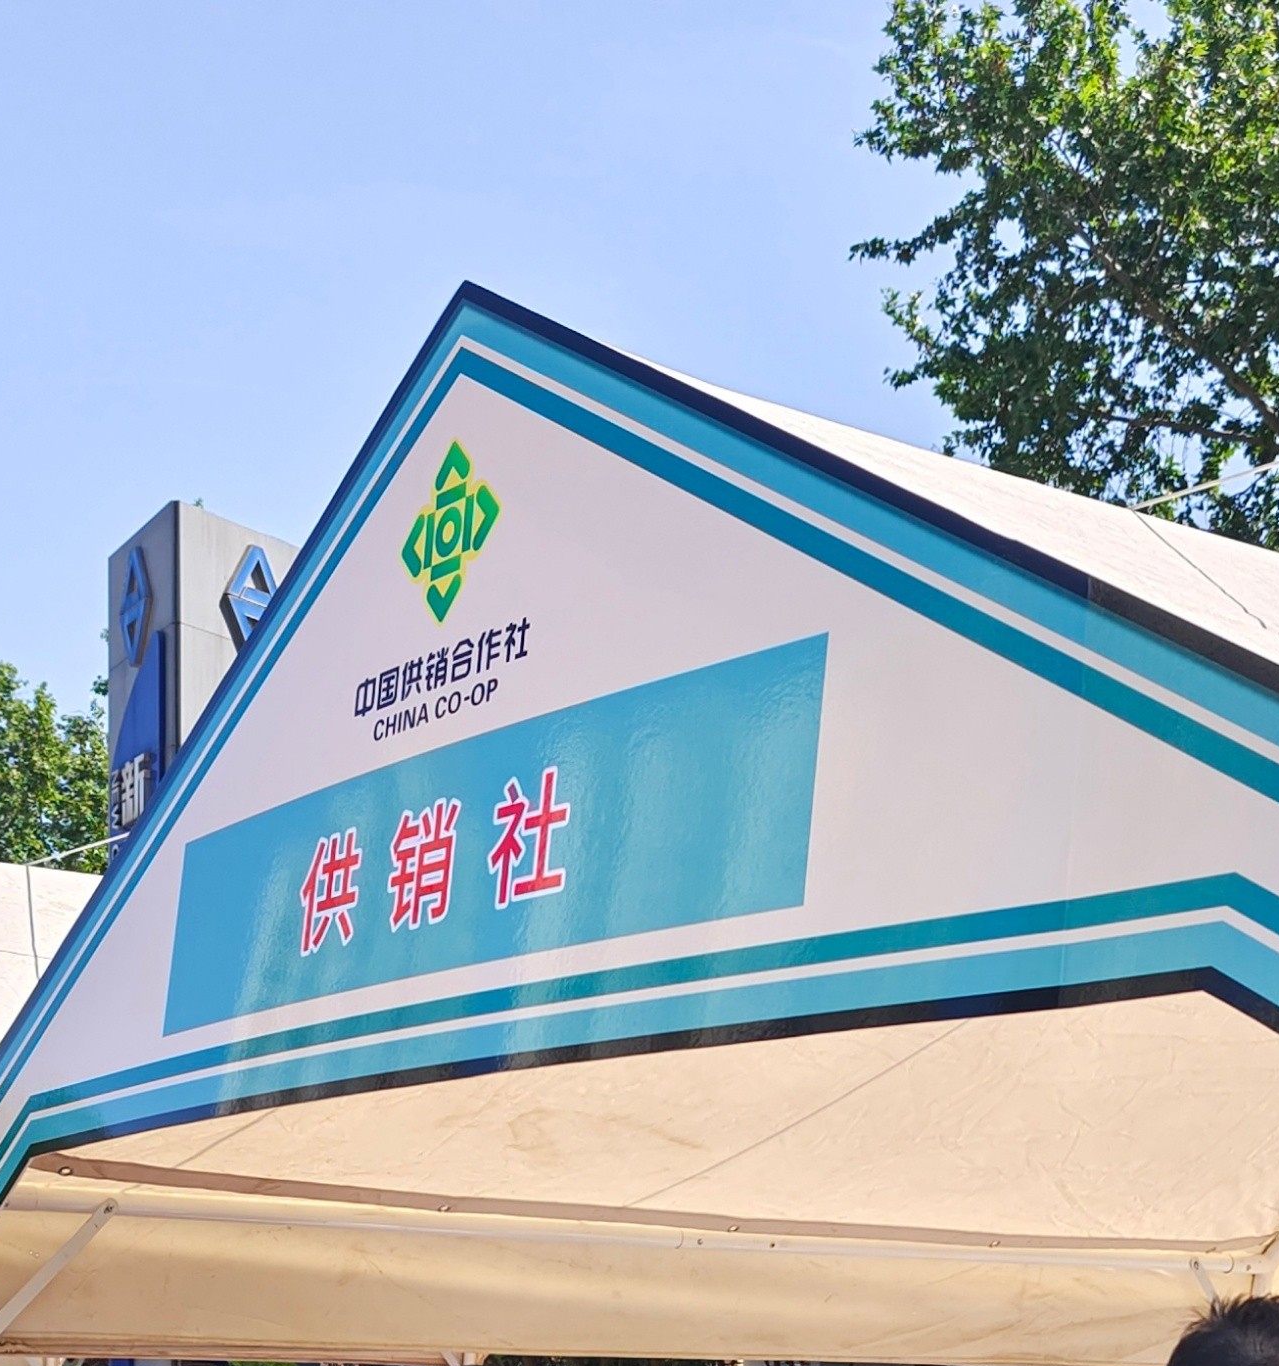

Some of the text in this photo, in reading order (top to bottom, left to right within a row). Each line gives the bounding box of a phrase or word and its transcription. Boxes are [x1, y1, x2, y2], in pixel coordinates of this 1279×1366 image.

[353, 616, 531, 720] 中国供销合作社
[372, 678, 500, 742] CHINA CO-OP
[298, 764, 572, 958] 供销社
